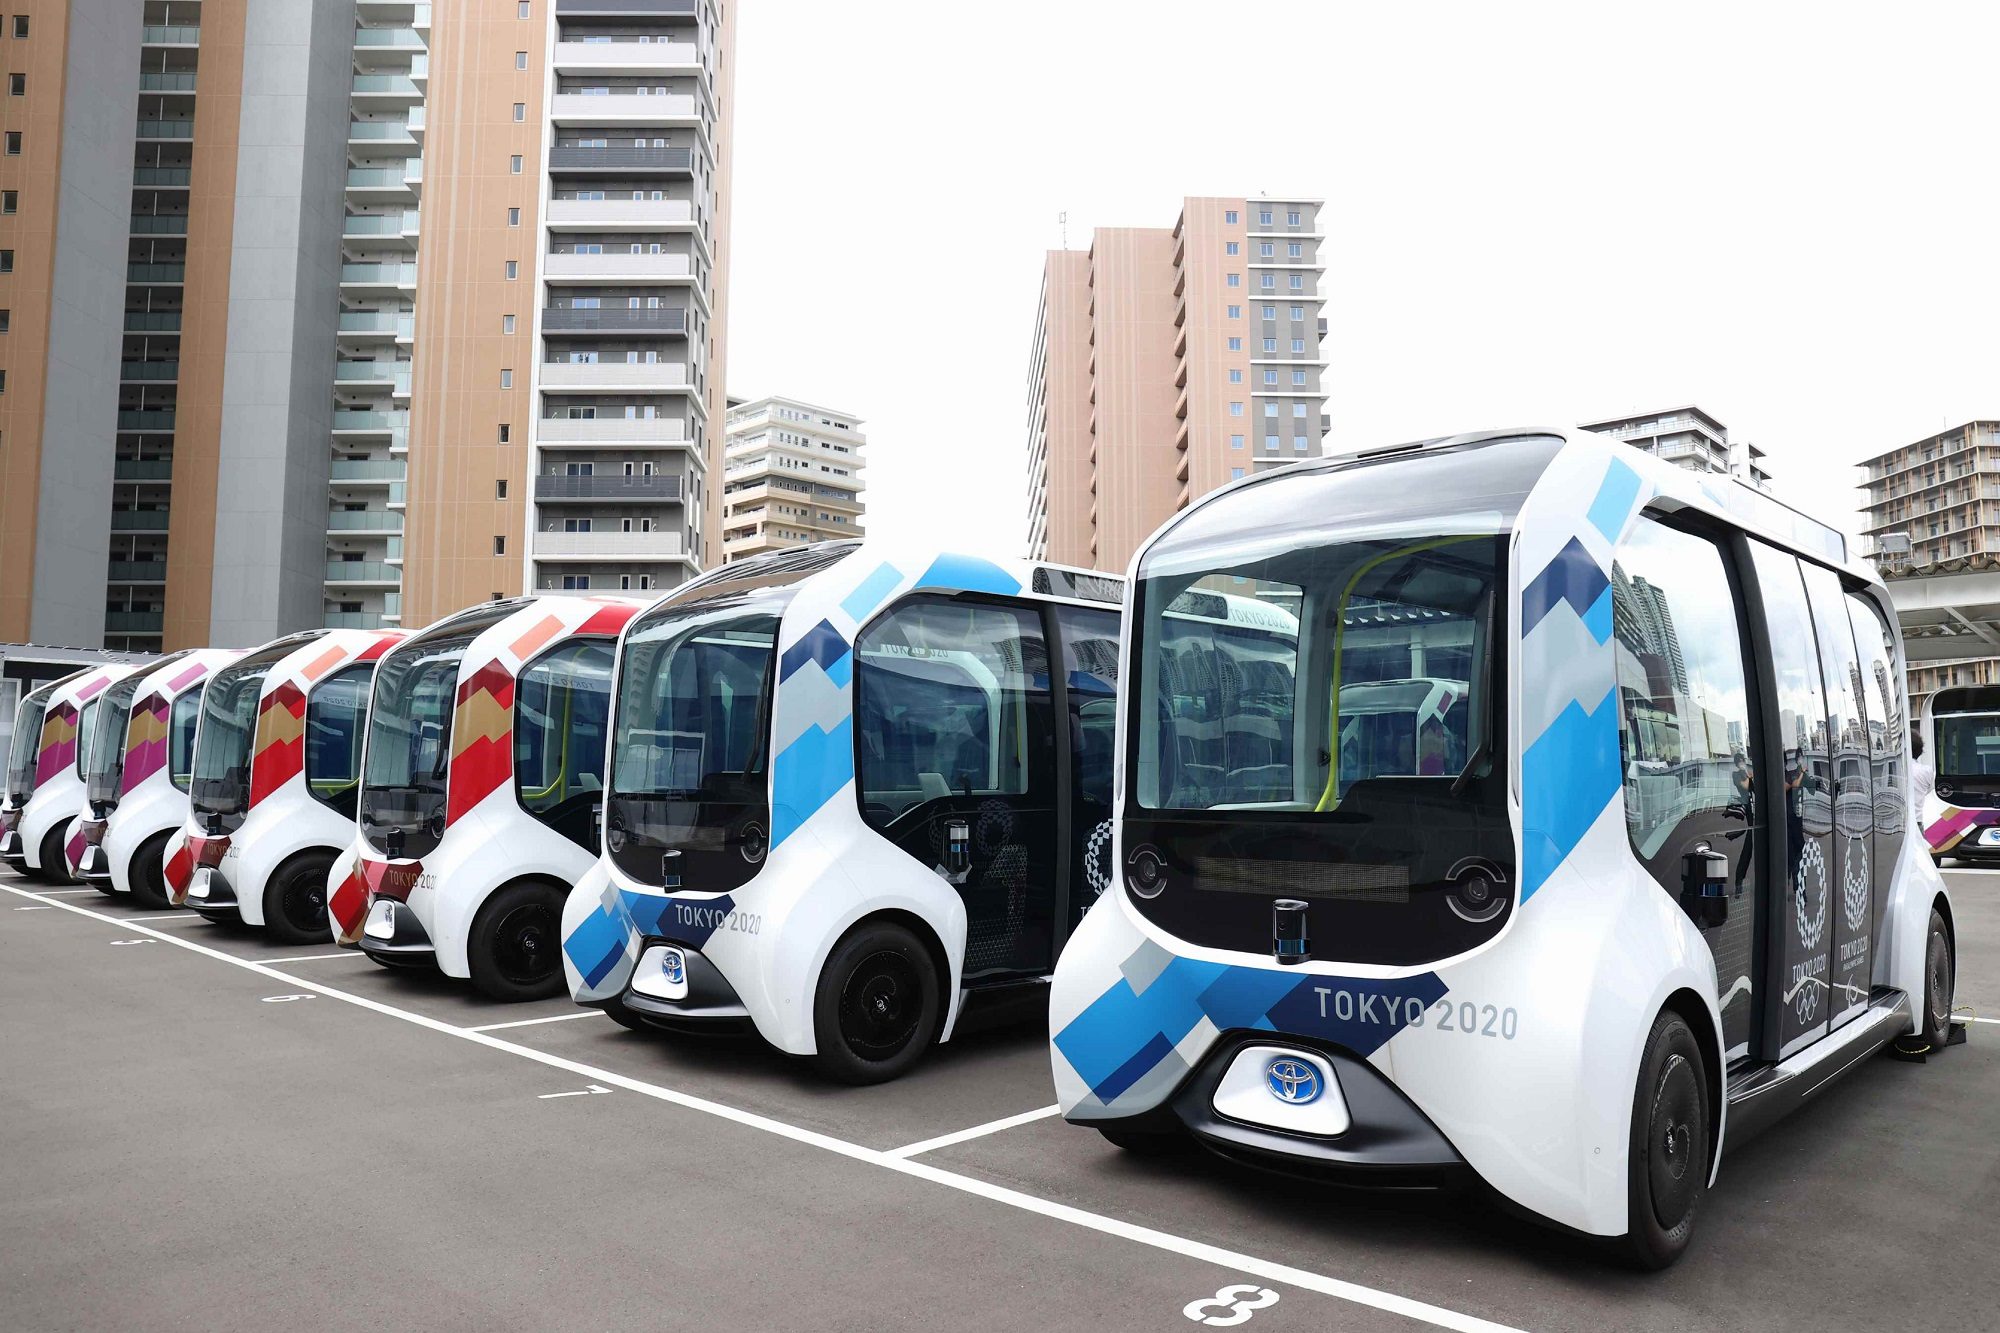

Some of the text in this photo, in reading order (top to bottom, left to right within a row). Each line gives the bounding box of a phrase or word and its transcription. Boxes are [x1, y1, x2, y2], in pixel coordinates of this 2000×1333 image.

[389, 870, 419, 888] TOKYO
[675, 903, 762, 935] TOKYO 2020
[1841, 939, 1857, 961] TOKYO
[1793, 959, 1813, 984] TOKYO
[1813, 953, 1827, 976] 2020
[1314, 986, 1518, 1041] TOKYO 2020
[536, 1084, 615, 1099] 7
[1182, 1284, 1281, 1327] 8
